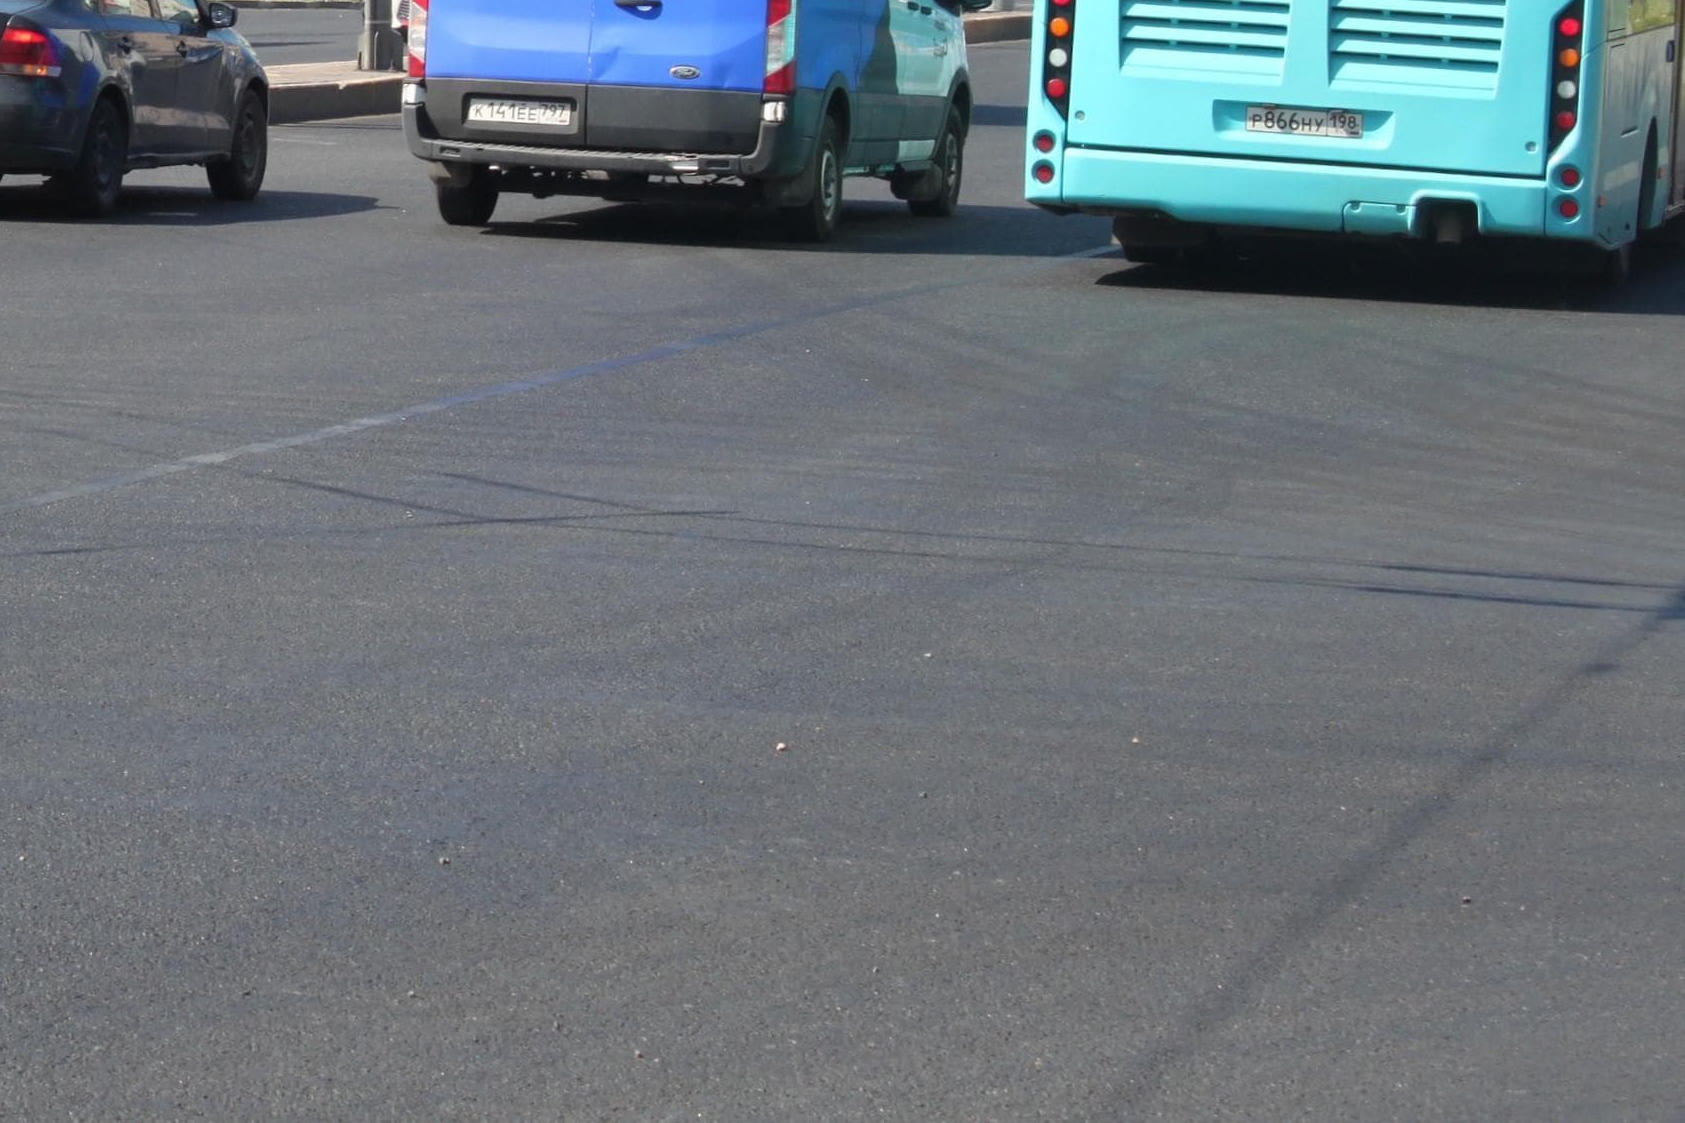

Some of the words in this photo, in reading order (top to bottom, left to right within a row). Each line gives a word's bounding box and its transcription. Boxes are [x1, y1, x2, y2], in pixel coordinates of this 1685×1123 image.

[474, 101, 537, 121] К141ЕЕ
[540, 103, 566, 118] 797
[1251, 110, 1325, 133] Р866НУ
[1329, 113, 1357, 130] 198
